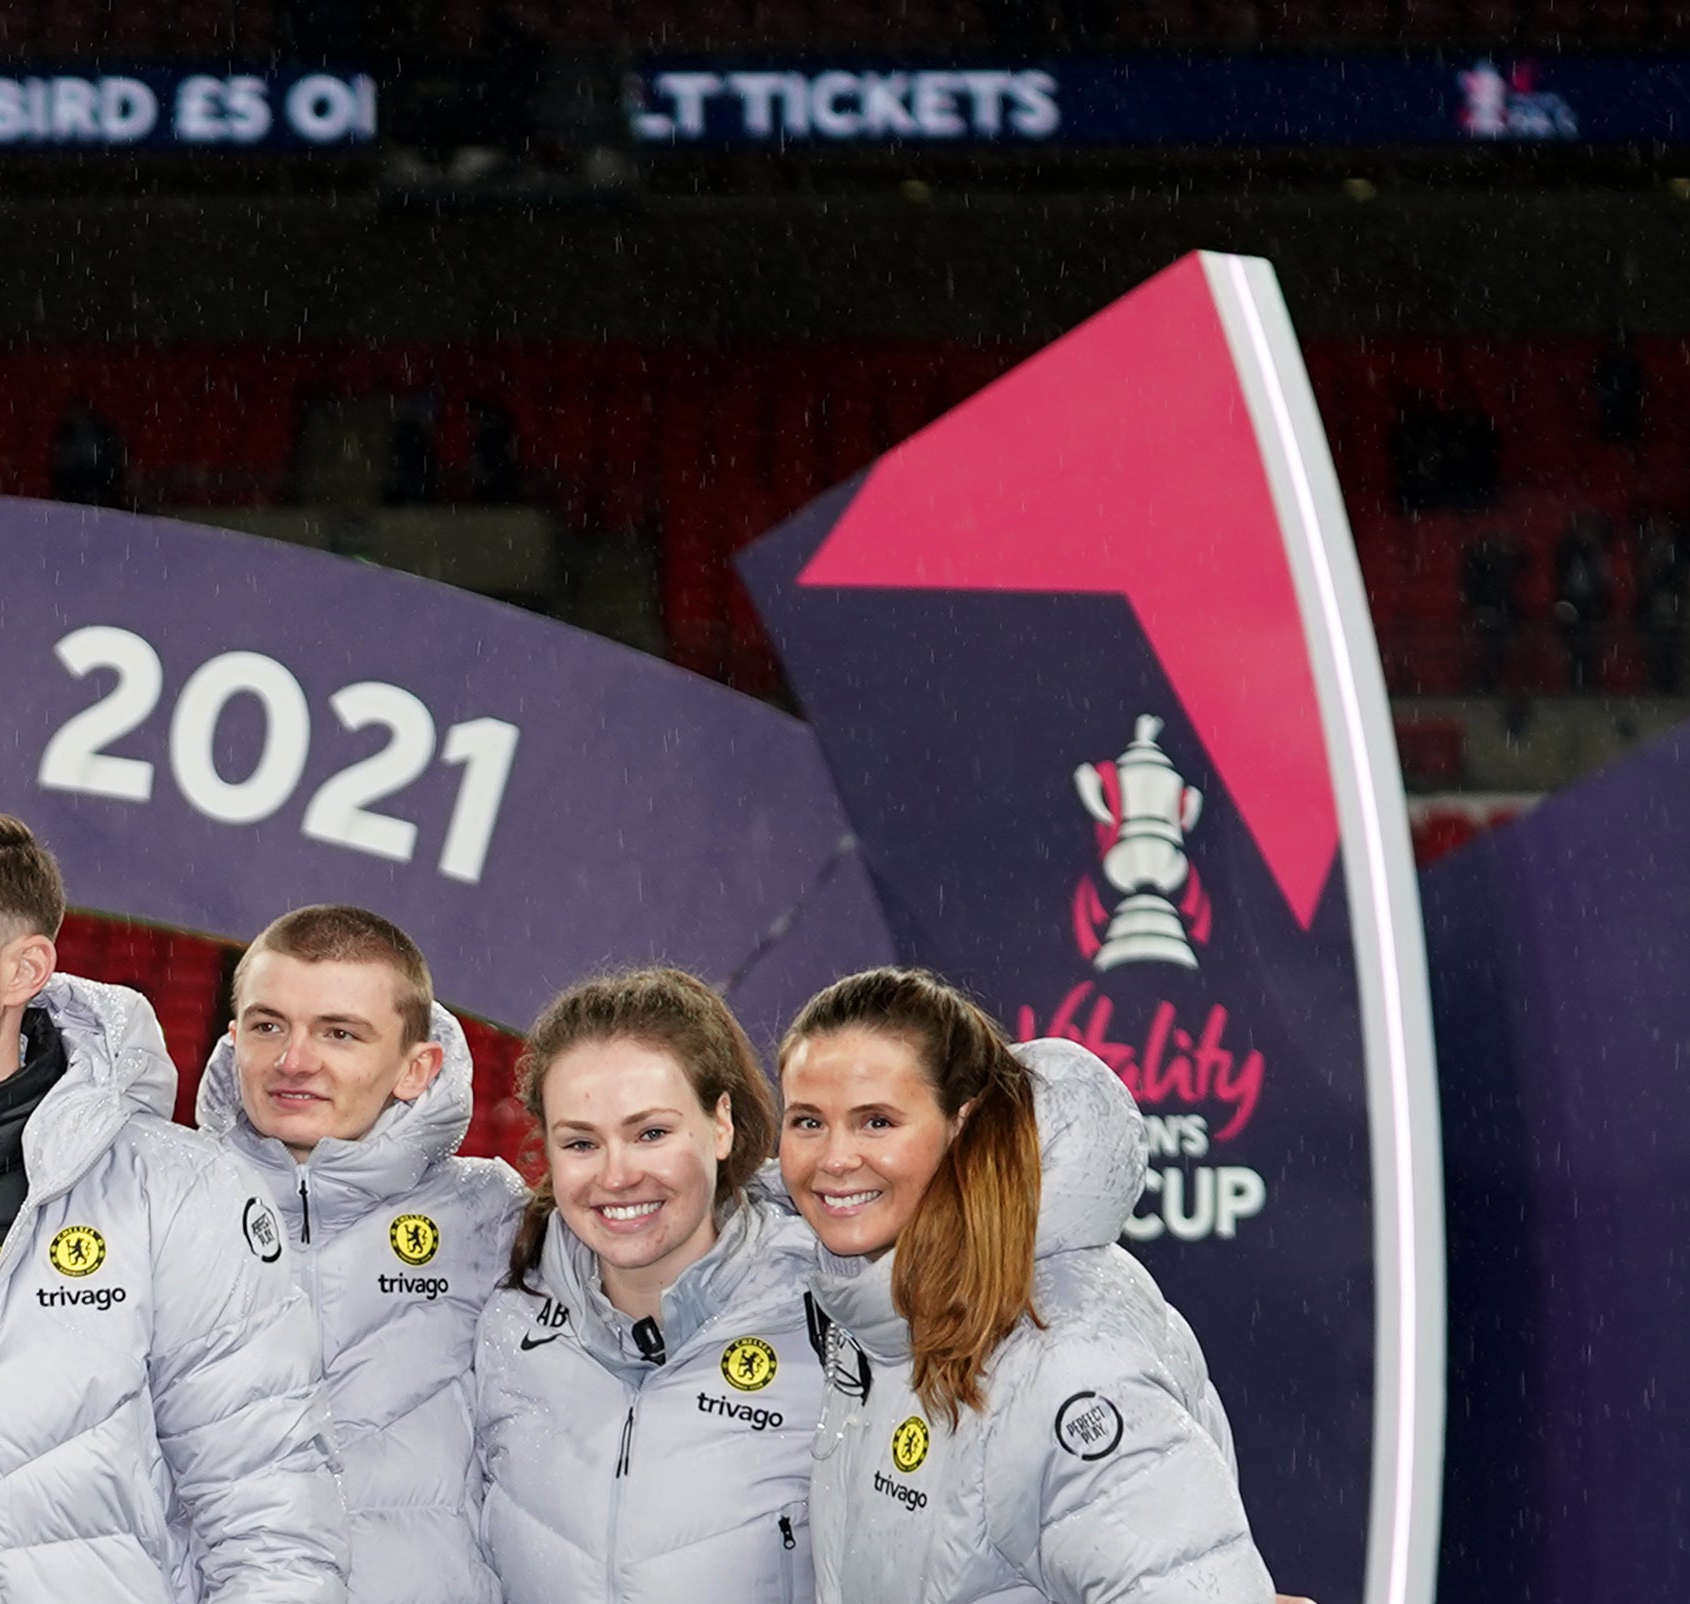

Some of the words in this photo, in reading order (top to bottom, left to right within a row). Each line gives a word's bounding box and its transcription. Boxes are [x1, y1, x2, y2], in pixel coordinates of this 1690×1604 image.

[725, 69, 1059, 136] TICKETS
[38, 624, 521, 884] 2021
[35, 1285, 127, 1311] trivago
[377, 1272, 449, 1301] trivago
[535, 1297, 570, 1328] AB
[696, 1392, 784, 1431] trivago
[1065, 1405, 1106, 1437] PERFECT
[873, 1470, 928, 1512] trivago
